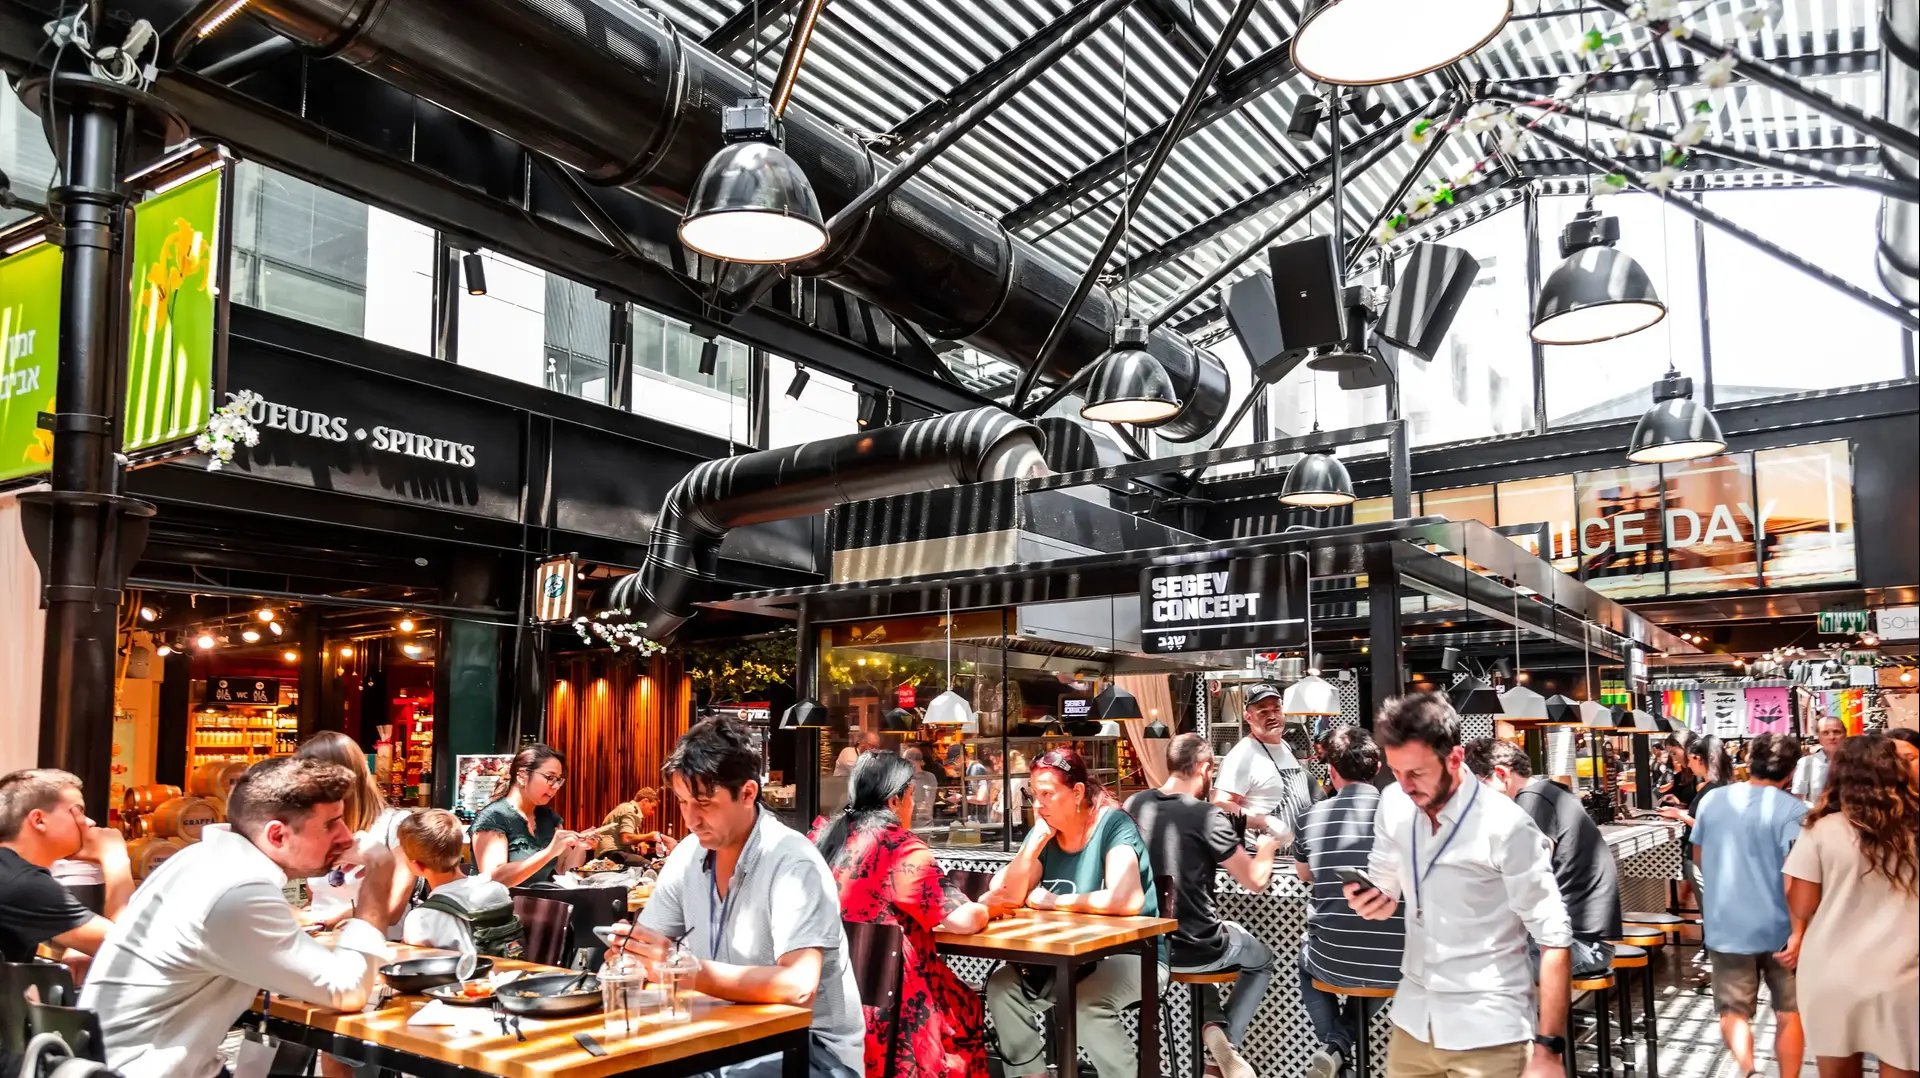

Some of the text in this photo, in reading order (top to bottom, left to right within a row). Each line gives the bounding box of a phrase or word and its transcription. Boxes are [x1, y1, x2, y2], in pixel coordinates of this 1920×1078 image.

[9, 330, 36, 367] זמן
[371, 425, 476, 468] SPIRITS
[1665, 498, 1778, 549] DAY
[1151, 571, 1229, 599] SEGEV
[1152, 592, 1261, 623] CONCEPT
[1881, 615, 1918, 630] SOH
[236, 691, 248, 699] WC
[1064, 699, 1086, 707] SEGEV
[1064, 706, 1092, 714] CONCEP
[183, 818, 216, 826] GRAPPA
